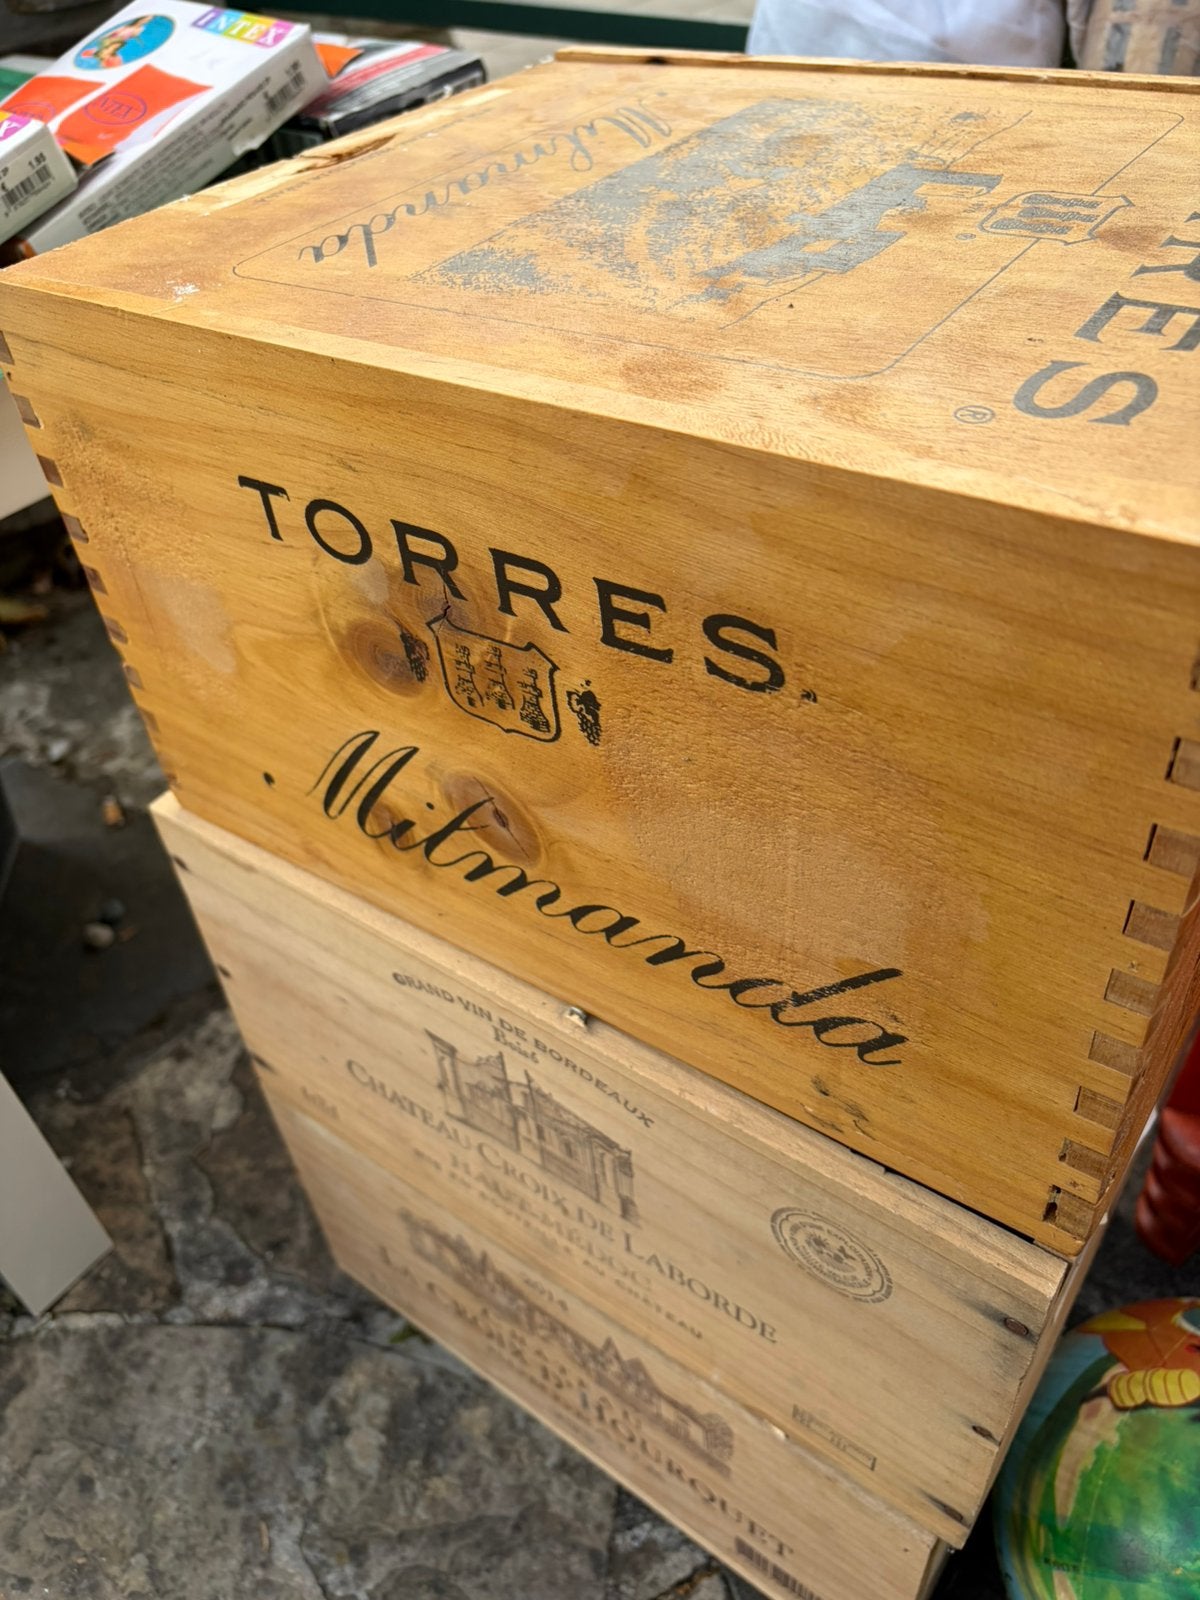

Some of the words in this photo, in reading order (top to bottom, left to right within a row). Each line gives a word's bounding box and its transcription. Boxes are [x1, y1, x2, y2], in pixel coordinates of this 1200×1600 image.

[194, 8, 293, 47] INTEX
[298, 92, 672, 268] Milmanda
[1012, 211, 1200, 426] RES
[238, 475, 787, 695] TORRES
[263, 730, 910, 1066] Milmanda
[392, 972, 455, 1004] GRAND
[458, 993, 493, 1022] VIN
[498, 1016, 528, 1043] DE
[532, 1037, 656, 1129] BORDEAUX
[477, 1140, 571, 1217] CROIX
[576, 1206, 615, 1243] DE
[623, 1231, 779, 1345] LABORDE
